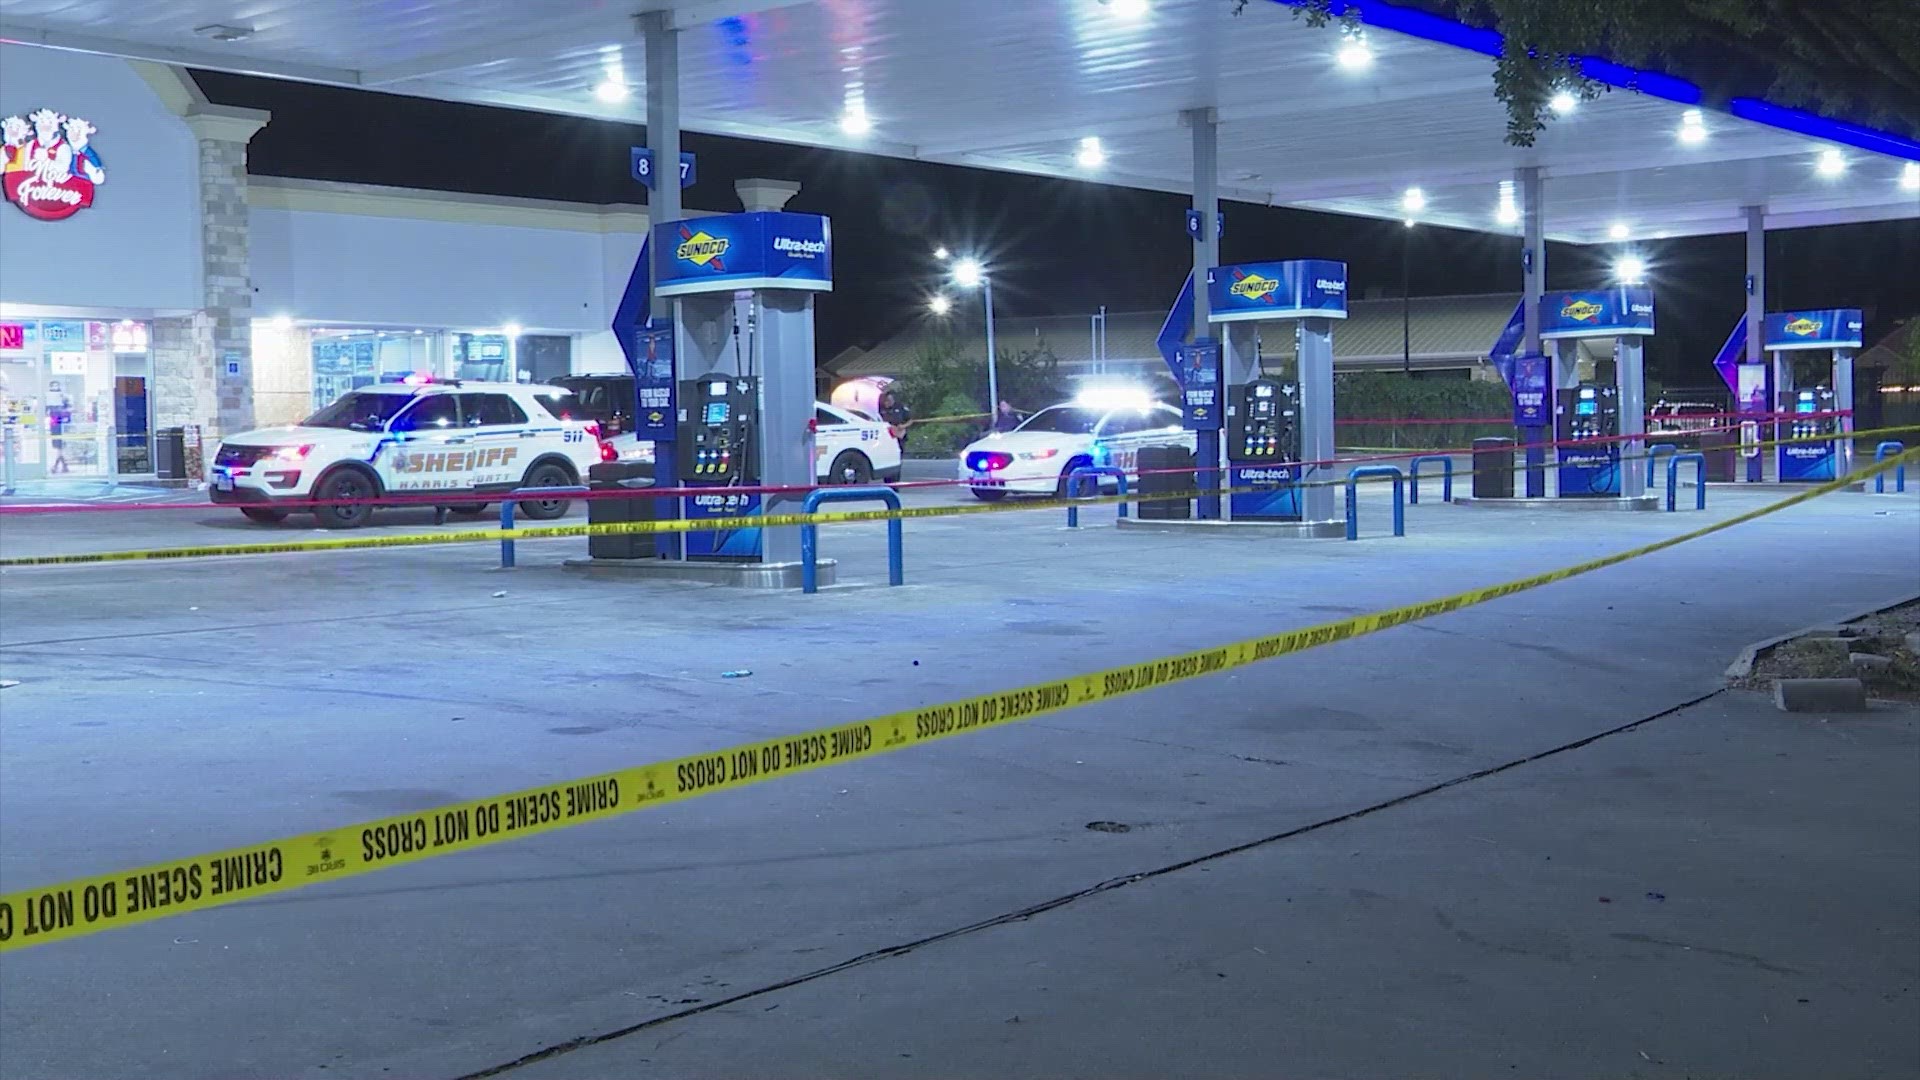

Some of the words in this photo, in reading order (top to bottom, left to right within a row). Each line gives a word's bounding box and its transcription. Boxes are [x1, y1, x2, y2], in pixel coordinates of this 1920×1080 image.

[638, 158, 649, 175] 8
[680, 163, 689, 179] 7
[17, 175, 83, 206] Forever
[1190, 217, 1198, 231] 6
[679, 240, 726, 257] SUNOCO
[774, 237, 825, 253] Ultra-tech
[1233, 281, 1276, 293] SUNOCO
[1563, 305, 1601, 316] SUNOCO
[1786, 322, 1822, 332] SUNOCO
[399, 479, 459, 489] HARRIS
[1240, 468, 1290, 479] Ultra-tech
[982, 698, 997, 724] DO
[1000, 690, 1034, 719] SCENE
[1035, 683, 1069, 712] CRIME
[916, 707, 954, 739] CROSS
[957, 702, 979, 729] NOT
[785, 735, 827, 769] SCENE
[831, 724, 872, 759] CRIME
[677, 756, 725, 793] CROSS
[731, 749, 757, 781] NOT
[762, 744, 780, 775] DO
[506, 789, 561, 831] SCENE
[566, 778, 619, 819] CRIME
[433, 809, 470, 846] NOT
[476, 803, 500, 837] DO
[361, 817, 427, 862] CROSS
[210, 847, 283, 896] CRIME
[84, 881, 117, 923] DO
[126, 863, 203, 914] SCENE
[23, 889, 74, 936] NOT
